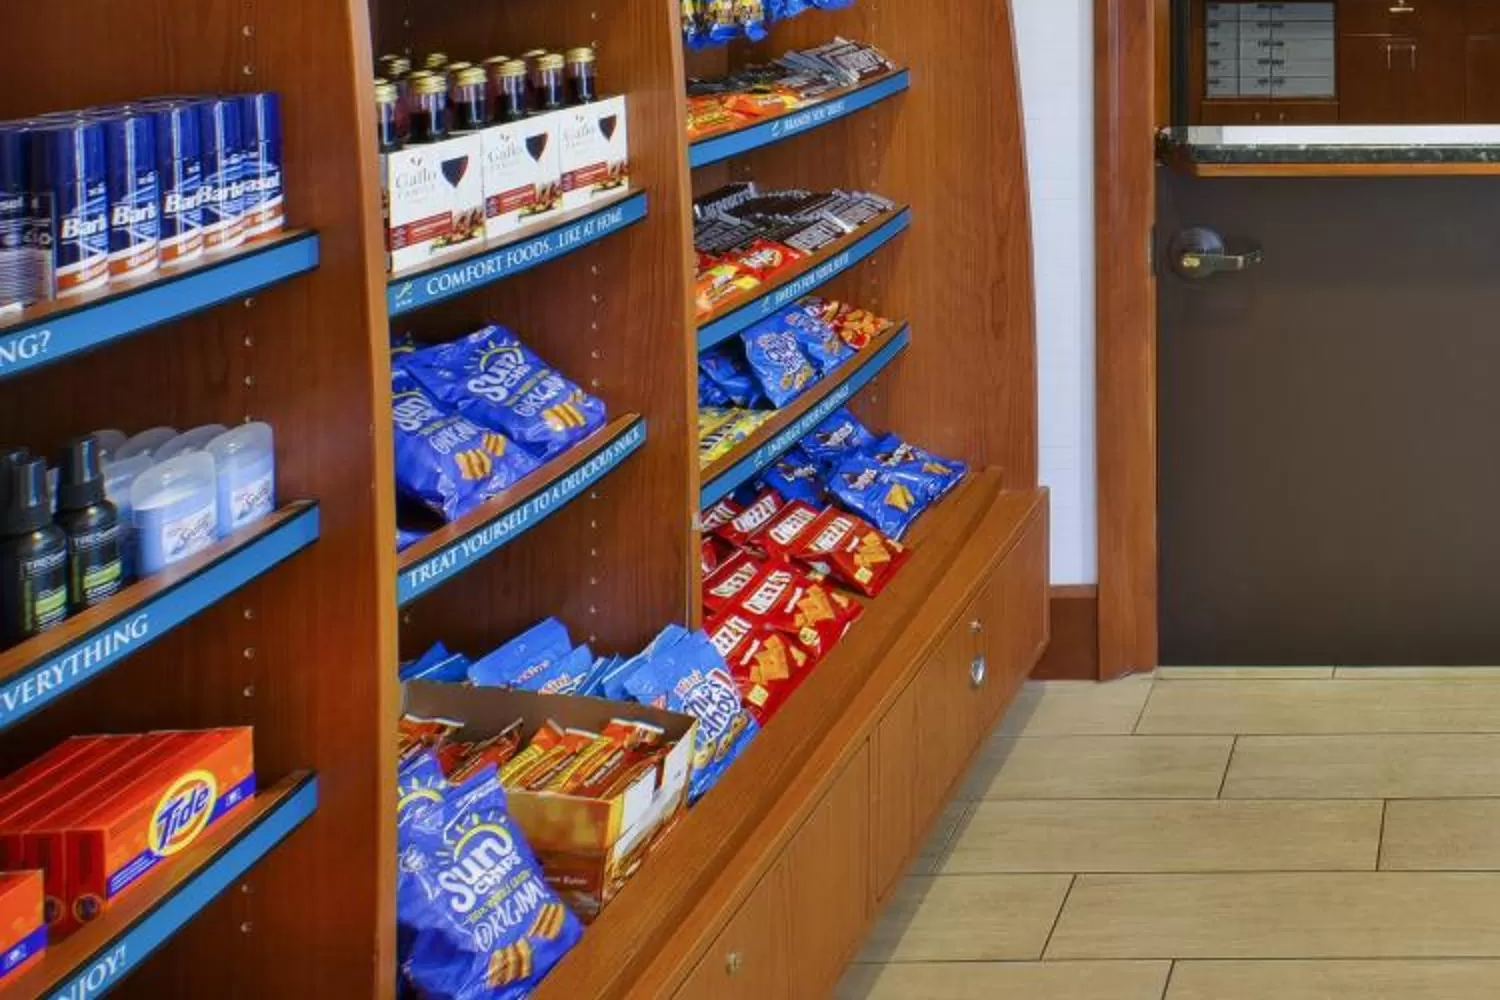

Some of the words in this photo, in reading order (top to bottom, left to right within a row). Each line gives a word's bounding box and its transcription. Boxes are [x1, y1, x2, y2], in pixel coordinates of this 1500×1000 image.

[426, 260, 505, 296] COMFORT
[407, 549, 458, 588] TREAT
[461, 506, 530, 560] YOURSELF
[530, 491, 551, 514] TO
[0, 613, 149, 716] VERYTHING
[156, 786, 210, 850] Tide
[437, 837, 513, 913] Sun
